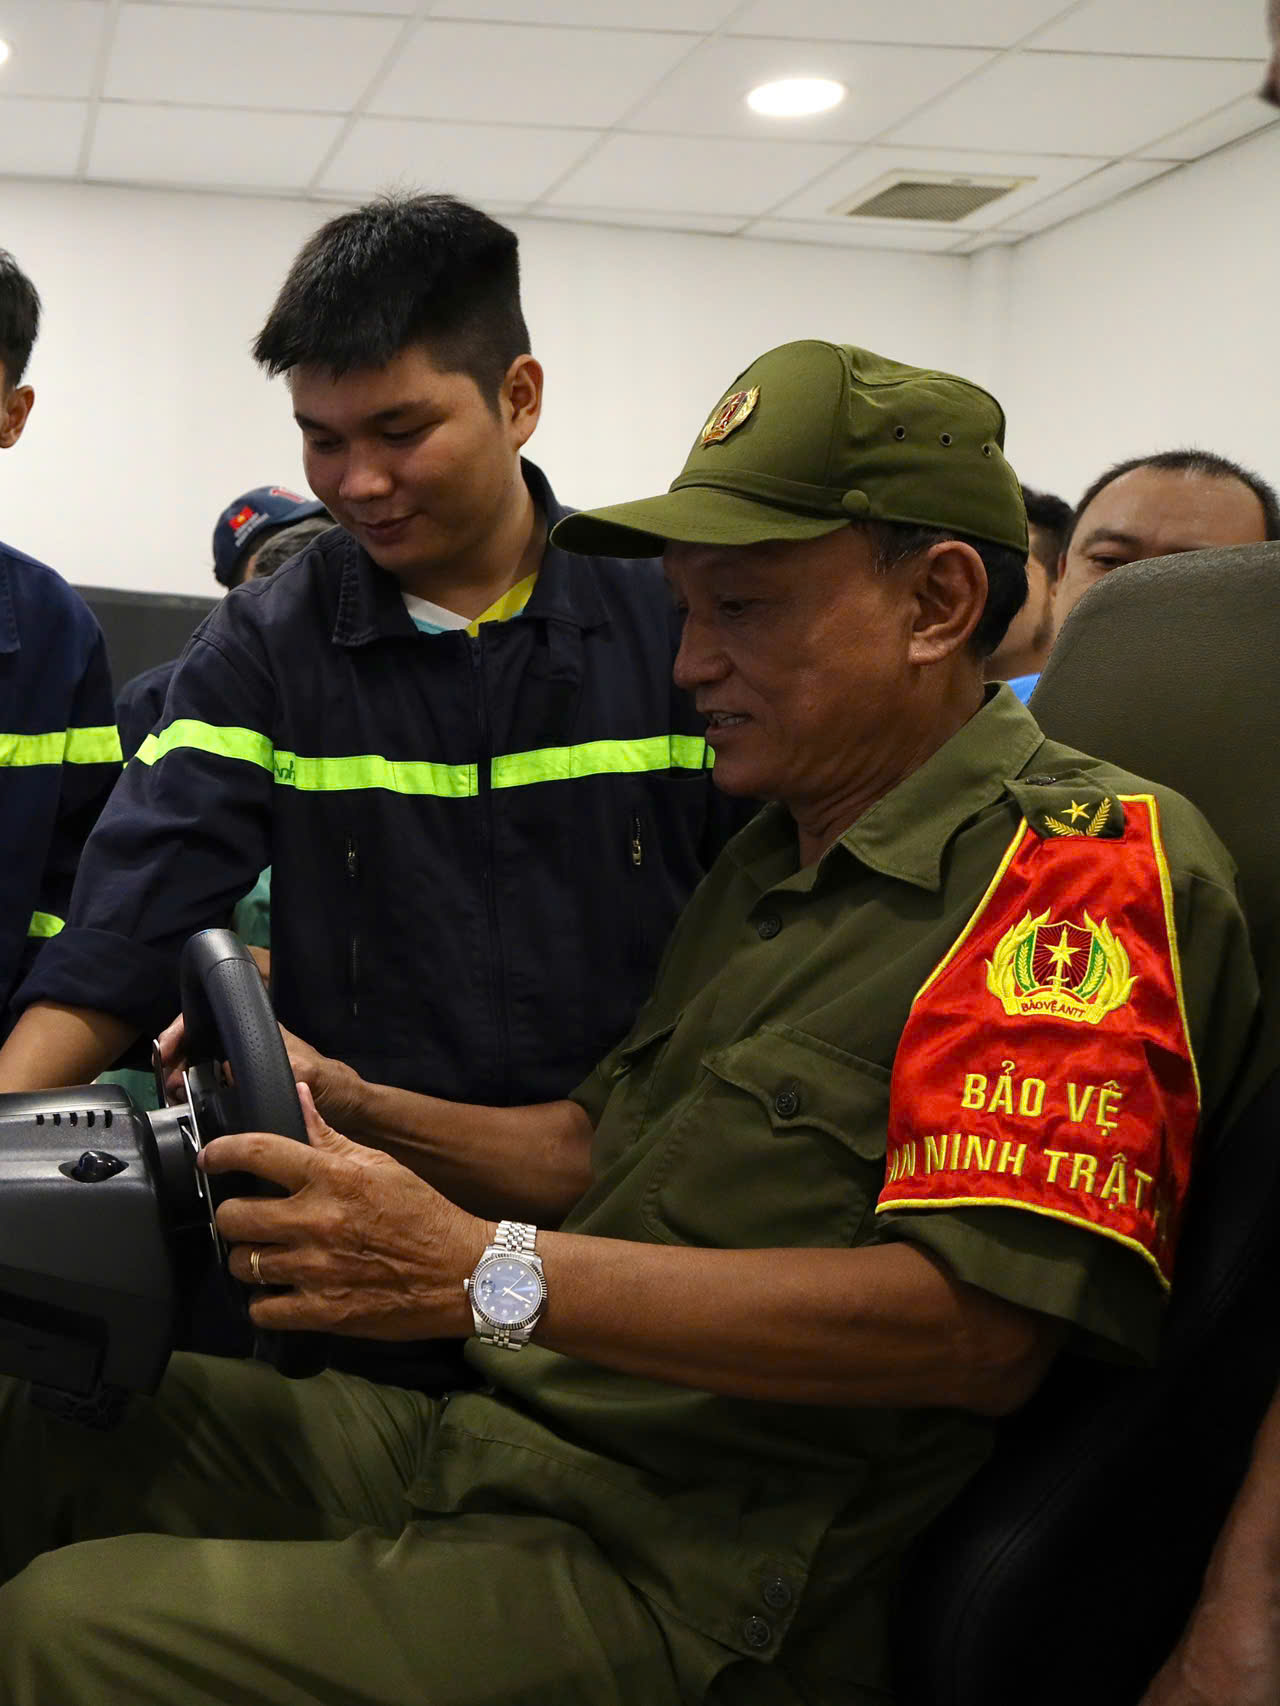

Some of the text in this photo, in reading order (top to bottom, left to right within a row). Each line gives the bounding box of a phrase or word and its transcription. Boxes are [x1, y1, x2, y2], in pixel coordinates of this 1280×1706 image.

[1021, 999, 1086, 1017] BẢO VỆ ANTT
[961, 1060, 1123, 1136] BẢO VỆ
[924, 1133, 1028, 1176] NINH
[1043, 1149, 1153, 1210] TRẬT
